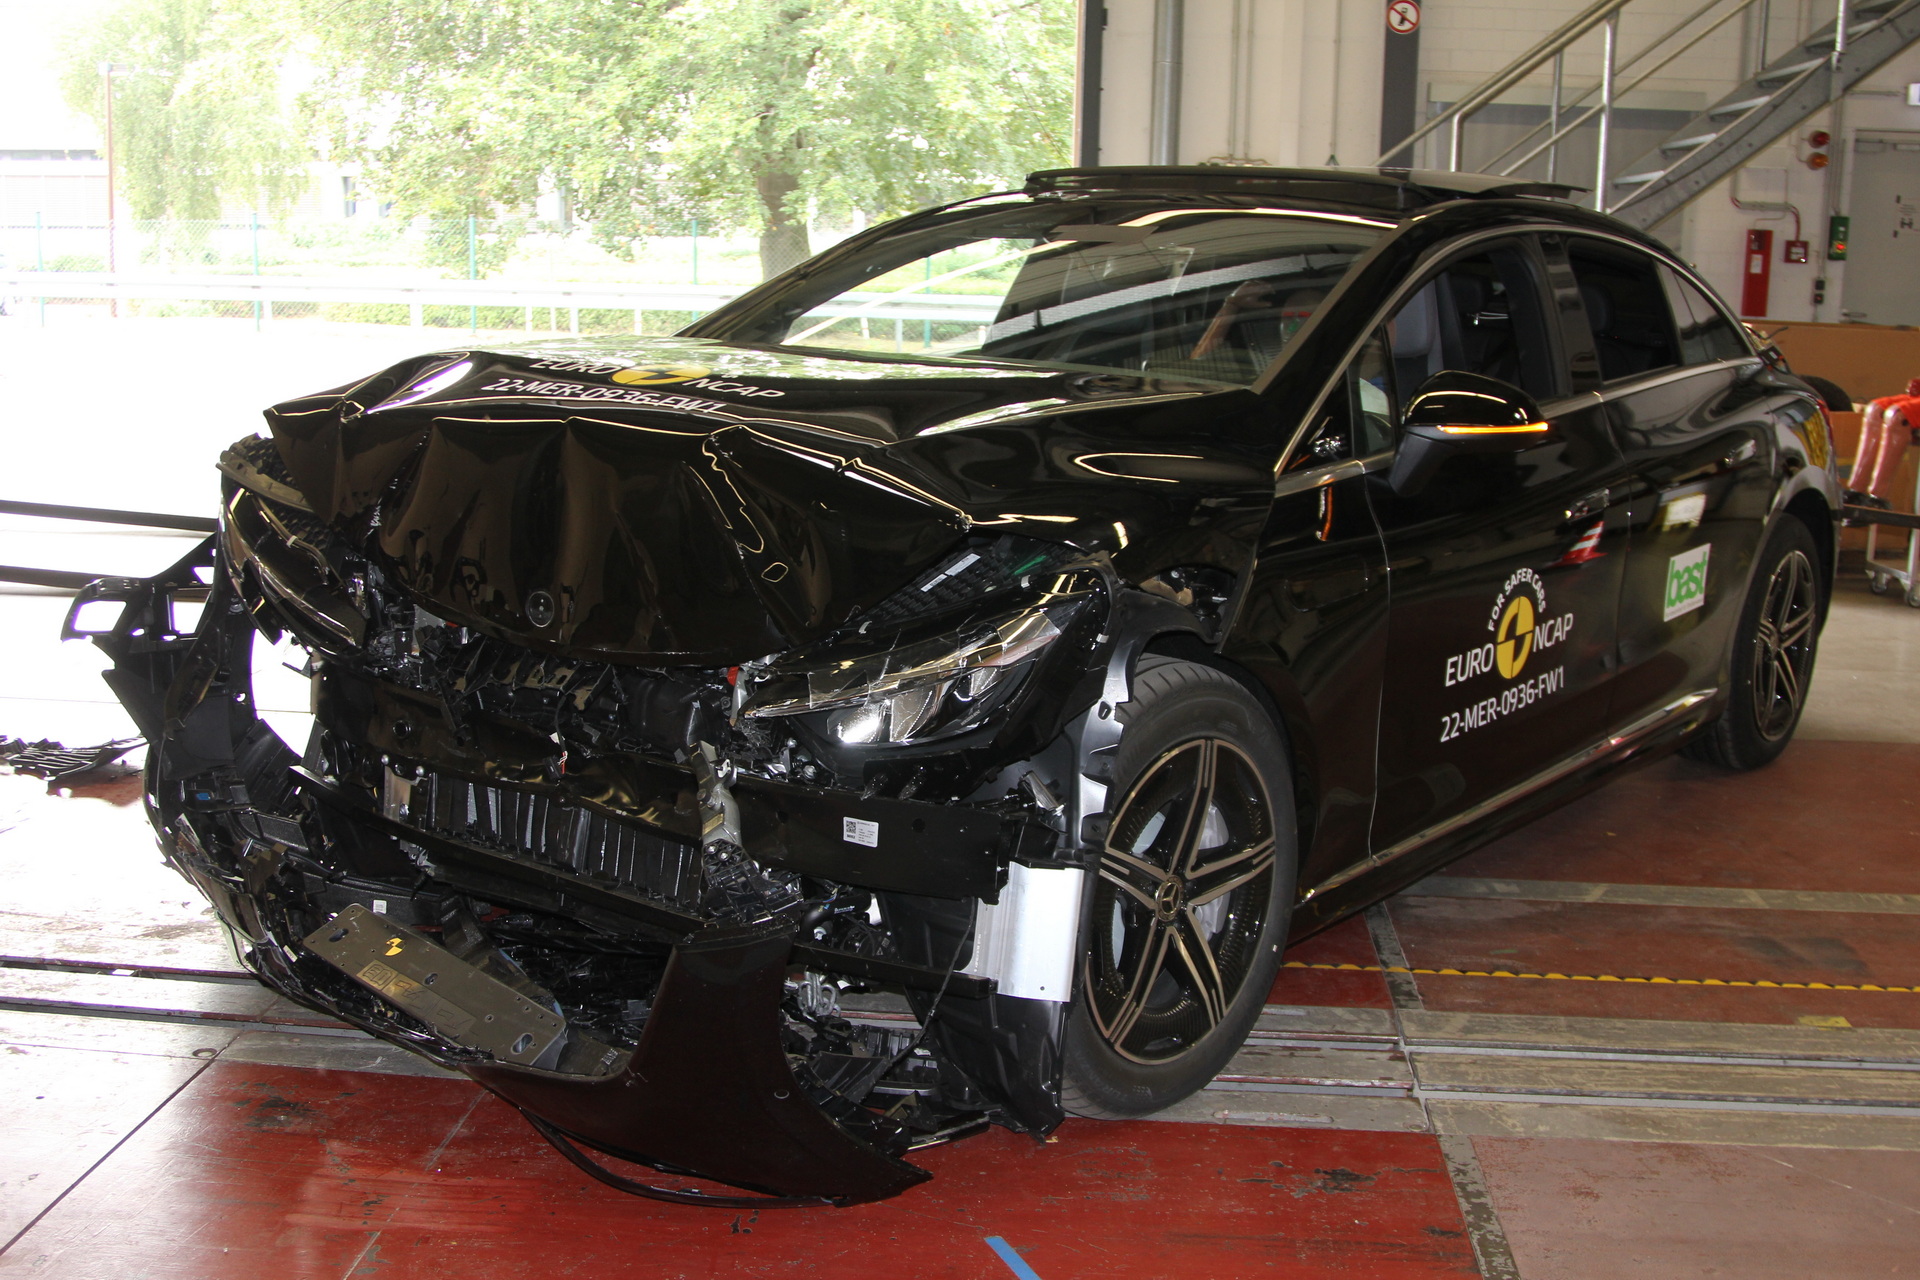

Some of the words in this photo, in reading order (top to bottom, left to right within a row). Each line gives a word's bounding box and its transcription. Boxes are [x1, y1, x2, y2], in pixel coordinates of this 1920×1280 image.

[481, 378, 727, 413] 22-MER-0936-FW1
[529, 357, 622, 374] EURO
[682, 378, 786, 397] NCAP
[1488, 593, 1506, 632] FOR
[1504, 568, 1533, 596] SAFER
[1532, 573, 1546, 613] CARS
[1666, 551, 1707, 609] bast
[1445, 643, 1494, 687] EURO
[1533, 613, 1574, 652] NCAP
[1440, 665, 1565, 743] 22-MER-0936-FW1
[1074, 1049, 1129, 1102] TURANZA
